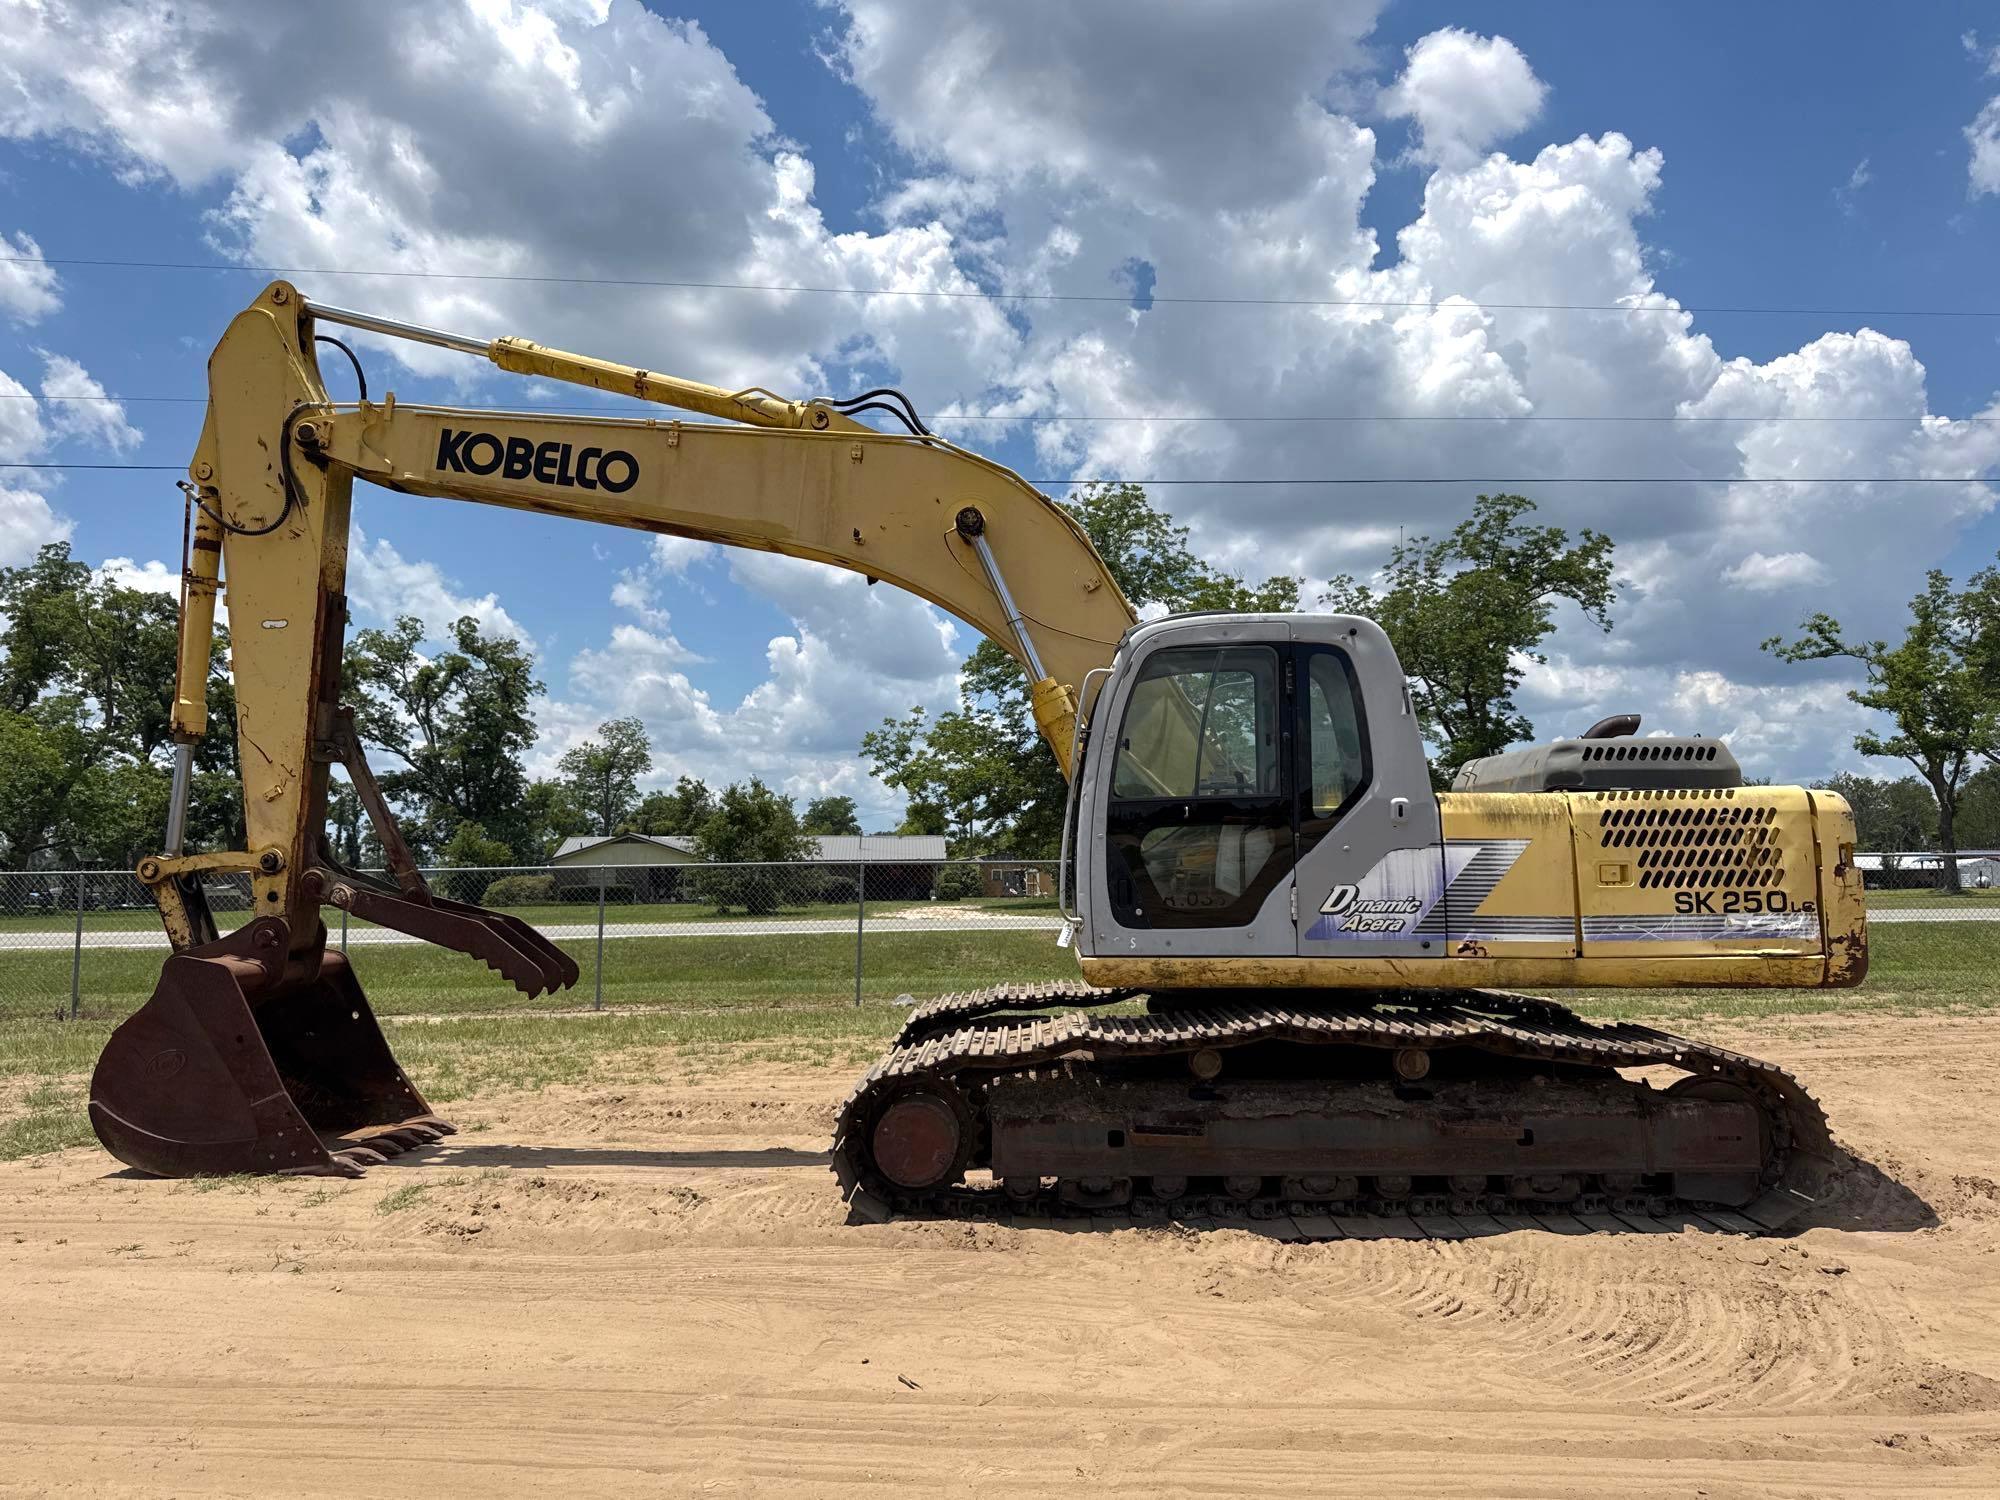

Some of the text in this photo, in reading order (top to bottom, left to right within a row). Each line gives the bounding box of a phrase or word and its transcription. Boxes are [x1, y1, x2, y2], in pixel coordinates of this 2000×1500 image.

[436, 428, 640, 493] KOBELCO
[1319, 884, 1423, 917] Dynamic
[1674, 891, 1717, 914] SK
[1338, 914, 1407, 933] Acera
